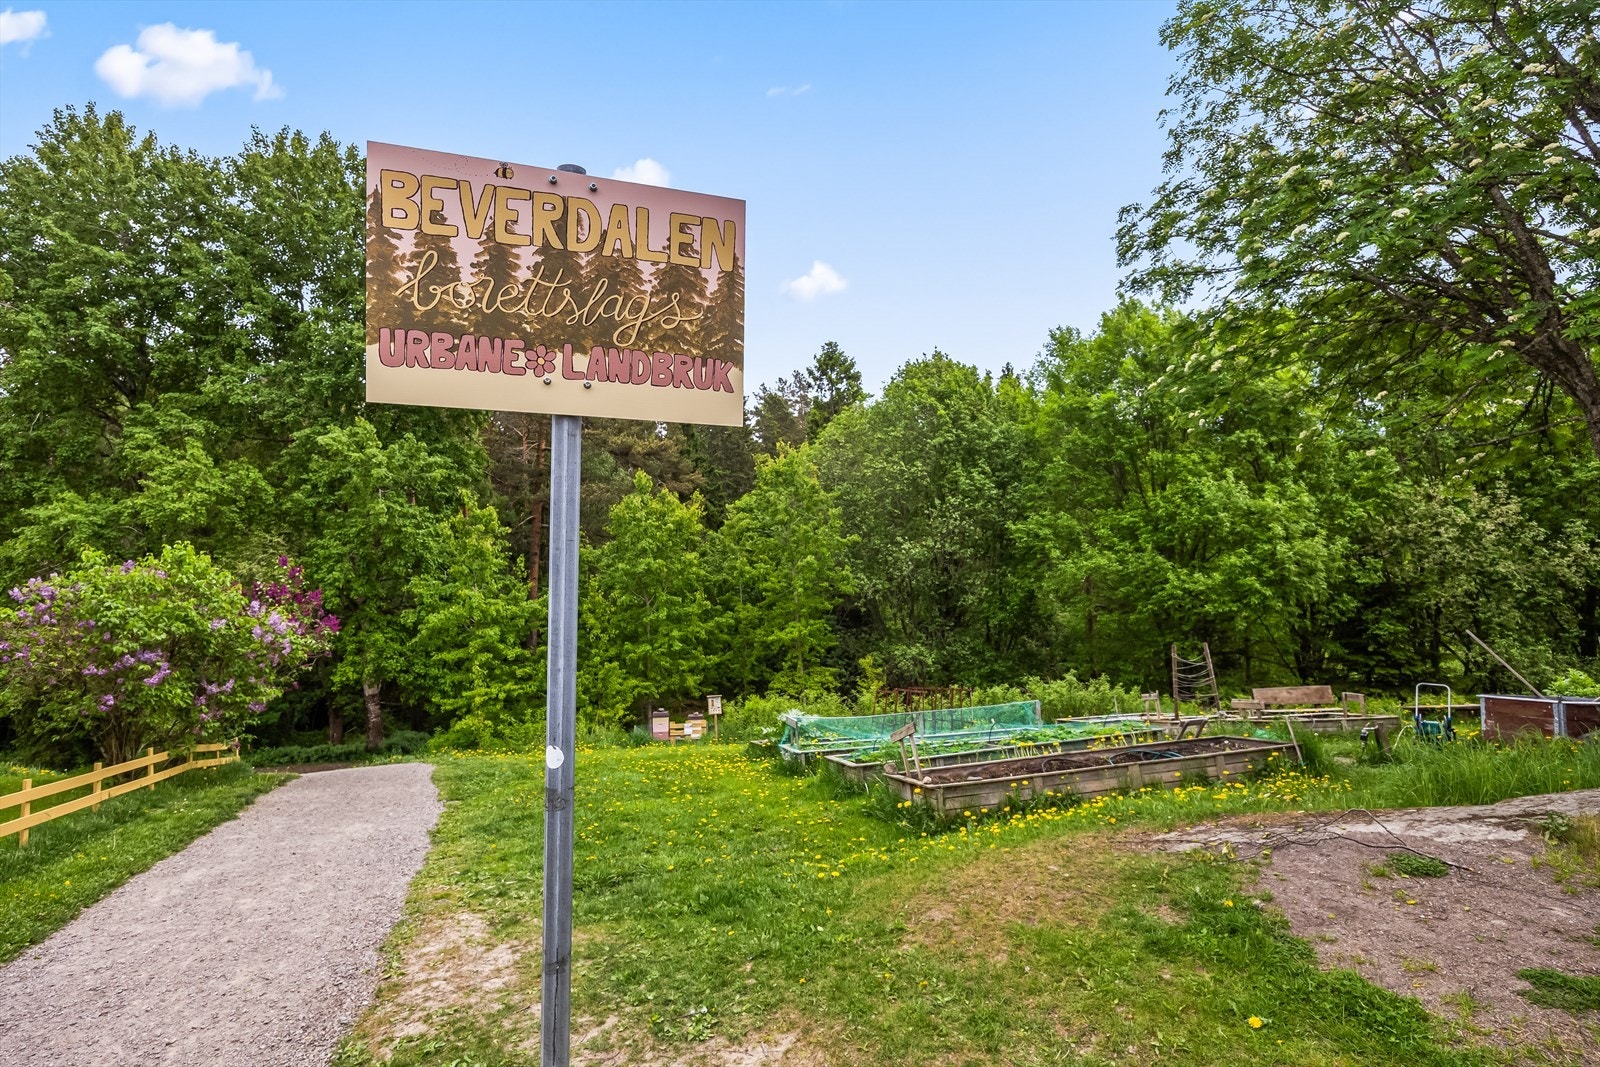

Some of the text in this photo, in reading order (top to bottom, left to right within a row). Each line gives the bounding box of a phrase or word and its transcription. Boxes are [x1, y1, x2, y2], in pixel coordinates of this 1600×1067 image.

[379, 168, 736, 272] BEVERDALEN
[395, 250, 703, 347] borettslags
[378, 327, 735, 394] URBANE LANDBRUK
